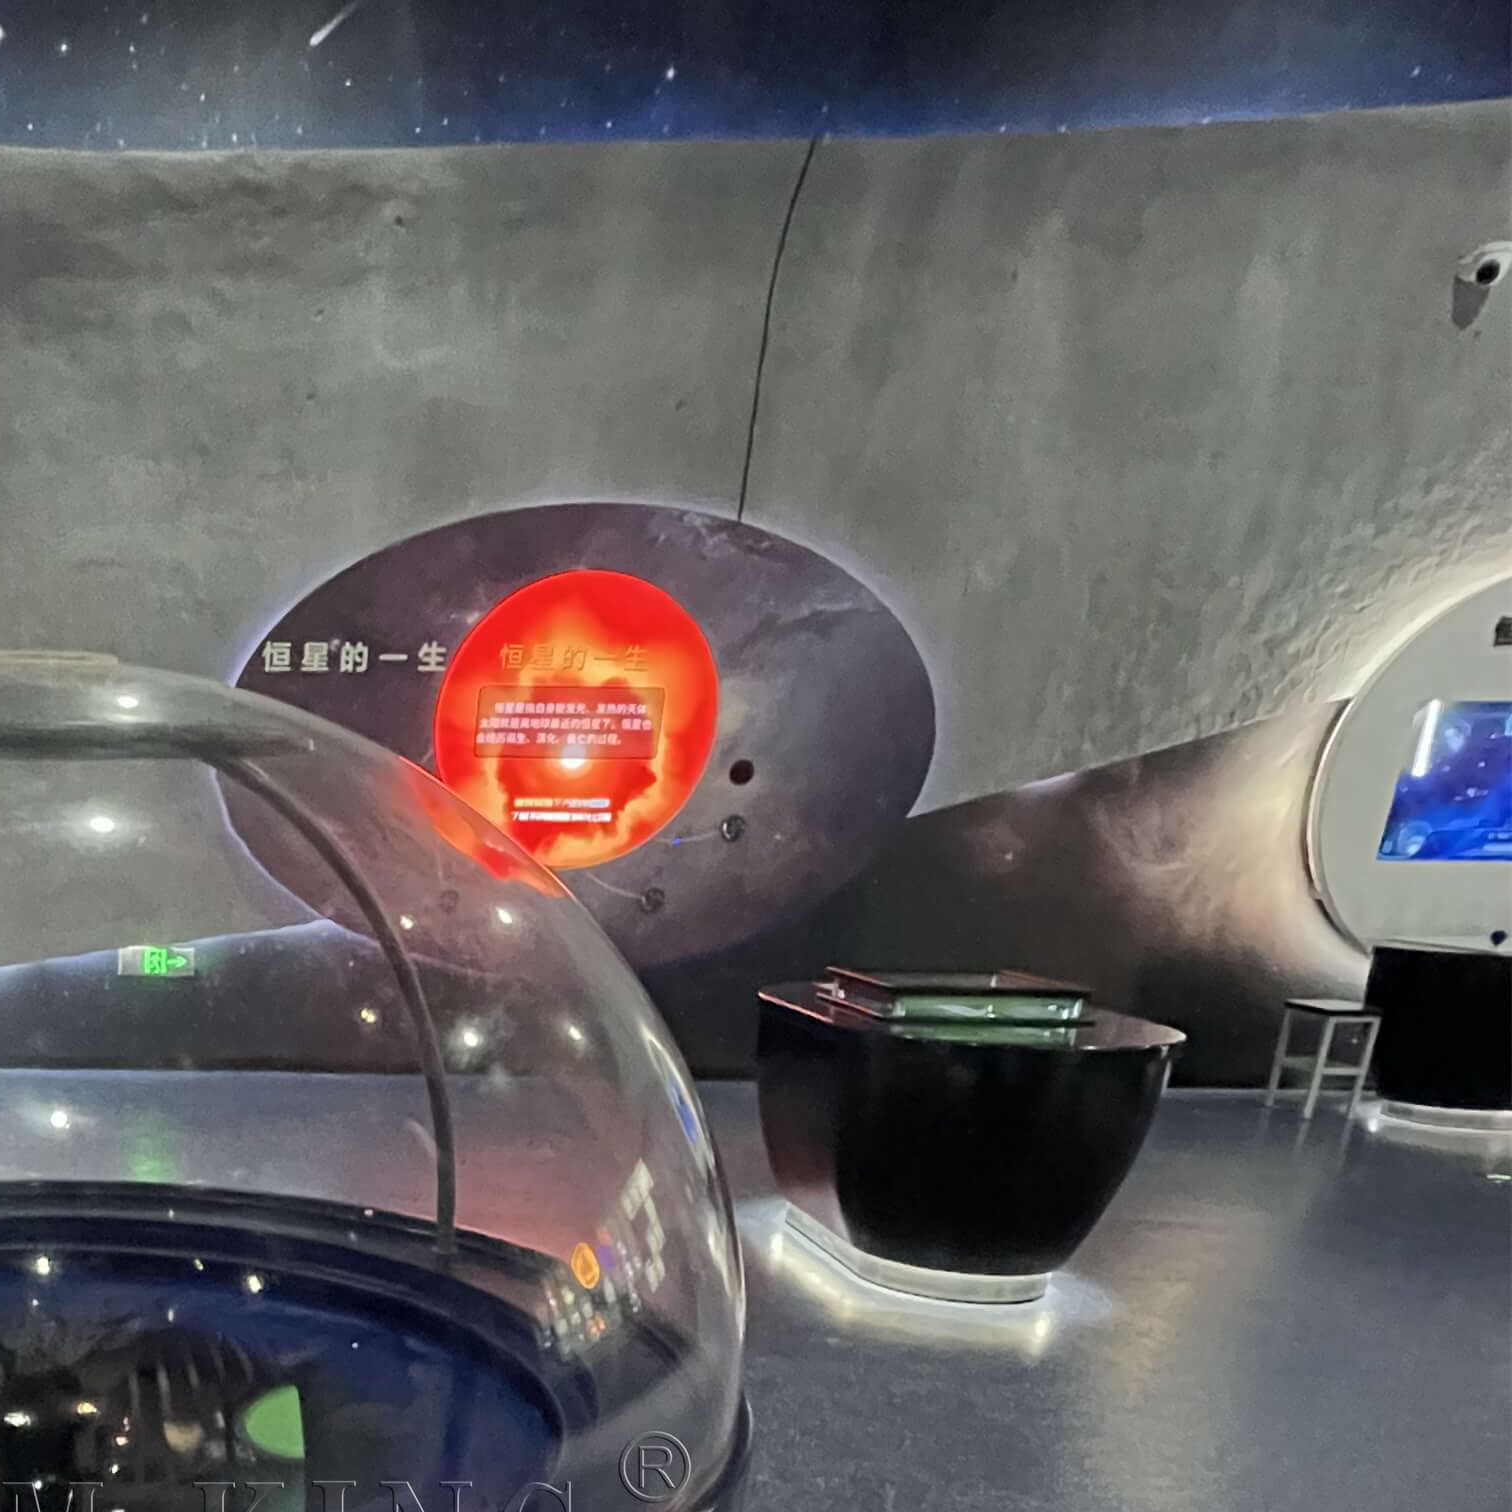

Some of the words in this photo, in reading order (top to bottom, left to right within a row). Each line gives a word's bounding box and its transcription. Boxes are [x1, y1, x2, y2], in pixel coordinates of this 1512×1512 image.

[262, 641, 448, 673] 恒星的一生
[499, 643, 649, 672] 恒星的一生
